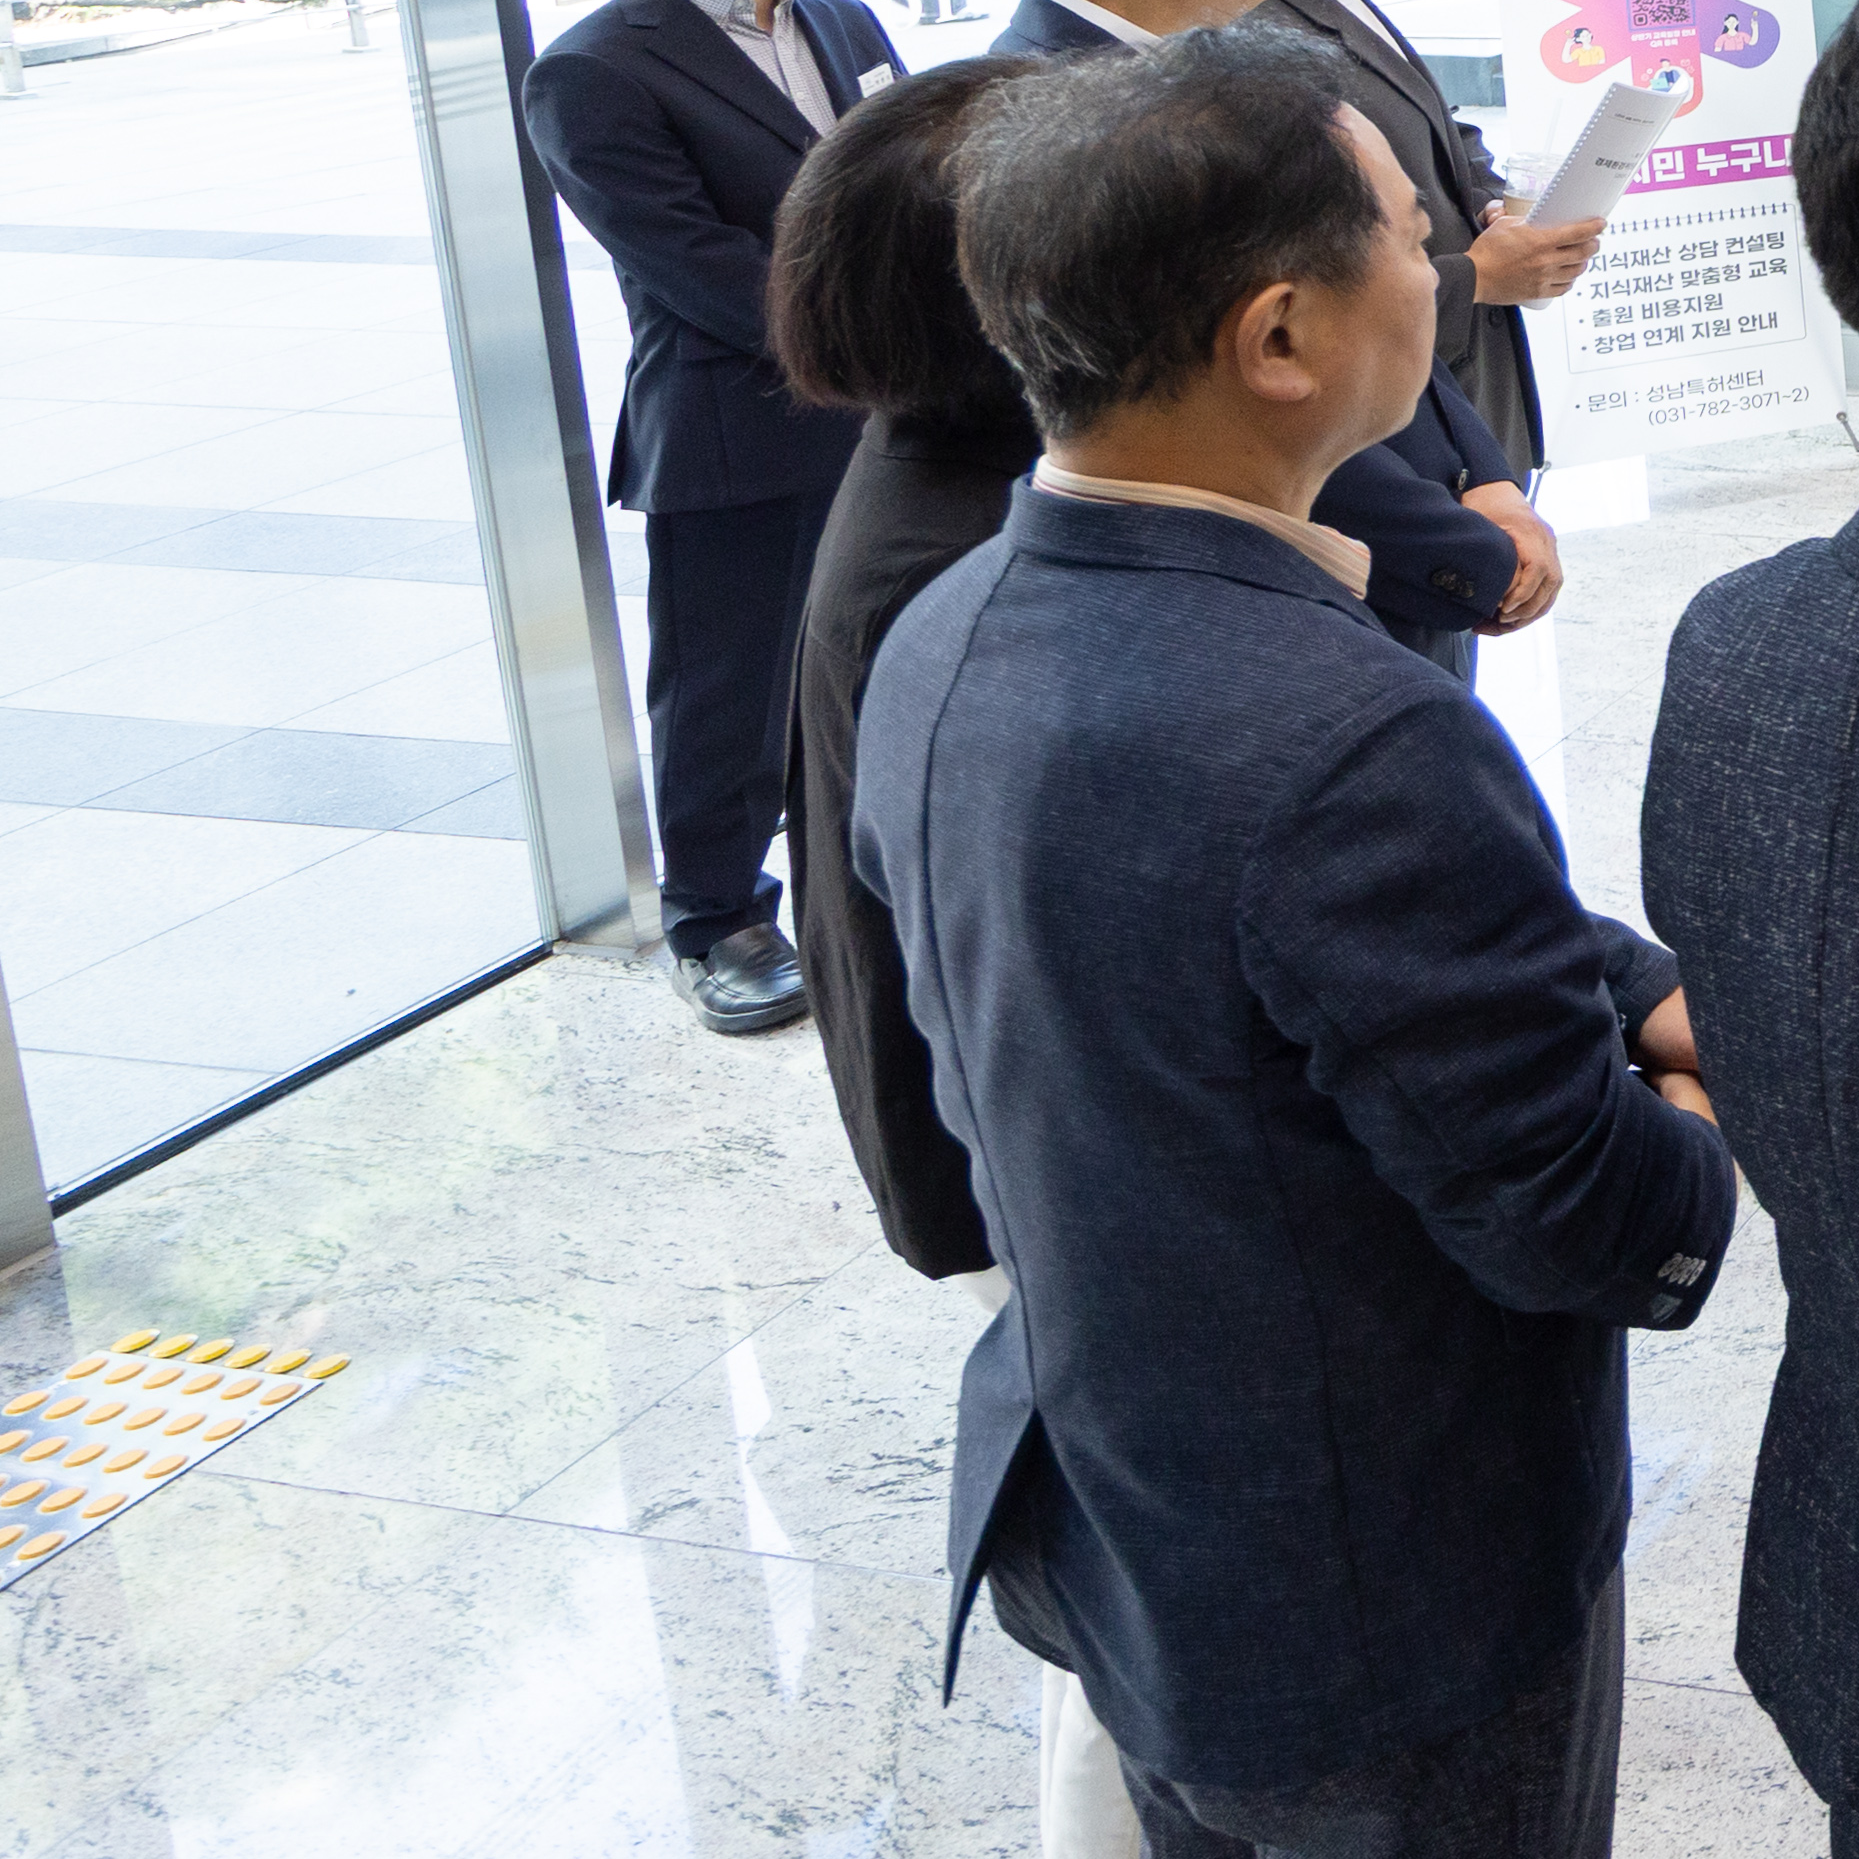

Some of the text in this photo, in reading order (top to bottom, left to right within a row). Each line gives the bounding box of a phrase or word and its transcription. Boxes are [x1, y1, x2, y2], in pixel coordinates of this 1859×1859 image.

[1588, 232, 1785, 273] 지식재산 상담 컨설팅
[1590, 258, 1787, 300] 지식재산 맞춤형 교육
[1592, 293, 1724, 328] 출원 비용지원
[1594, 312, 1778, 355] 창업 연계 지원 안내
[1588, 370, 1764, 412] 문의 성남특허센터
[1648, 386, 1809, 426] (031-782-3071~2)
